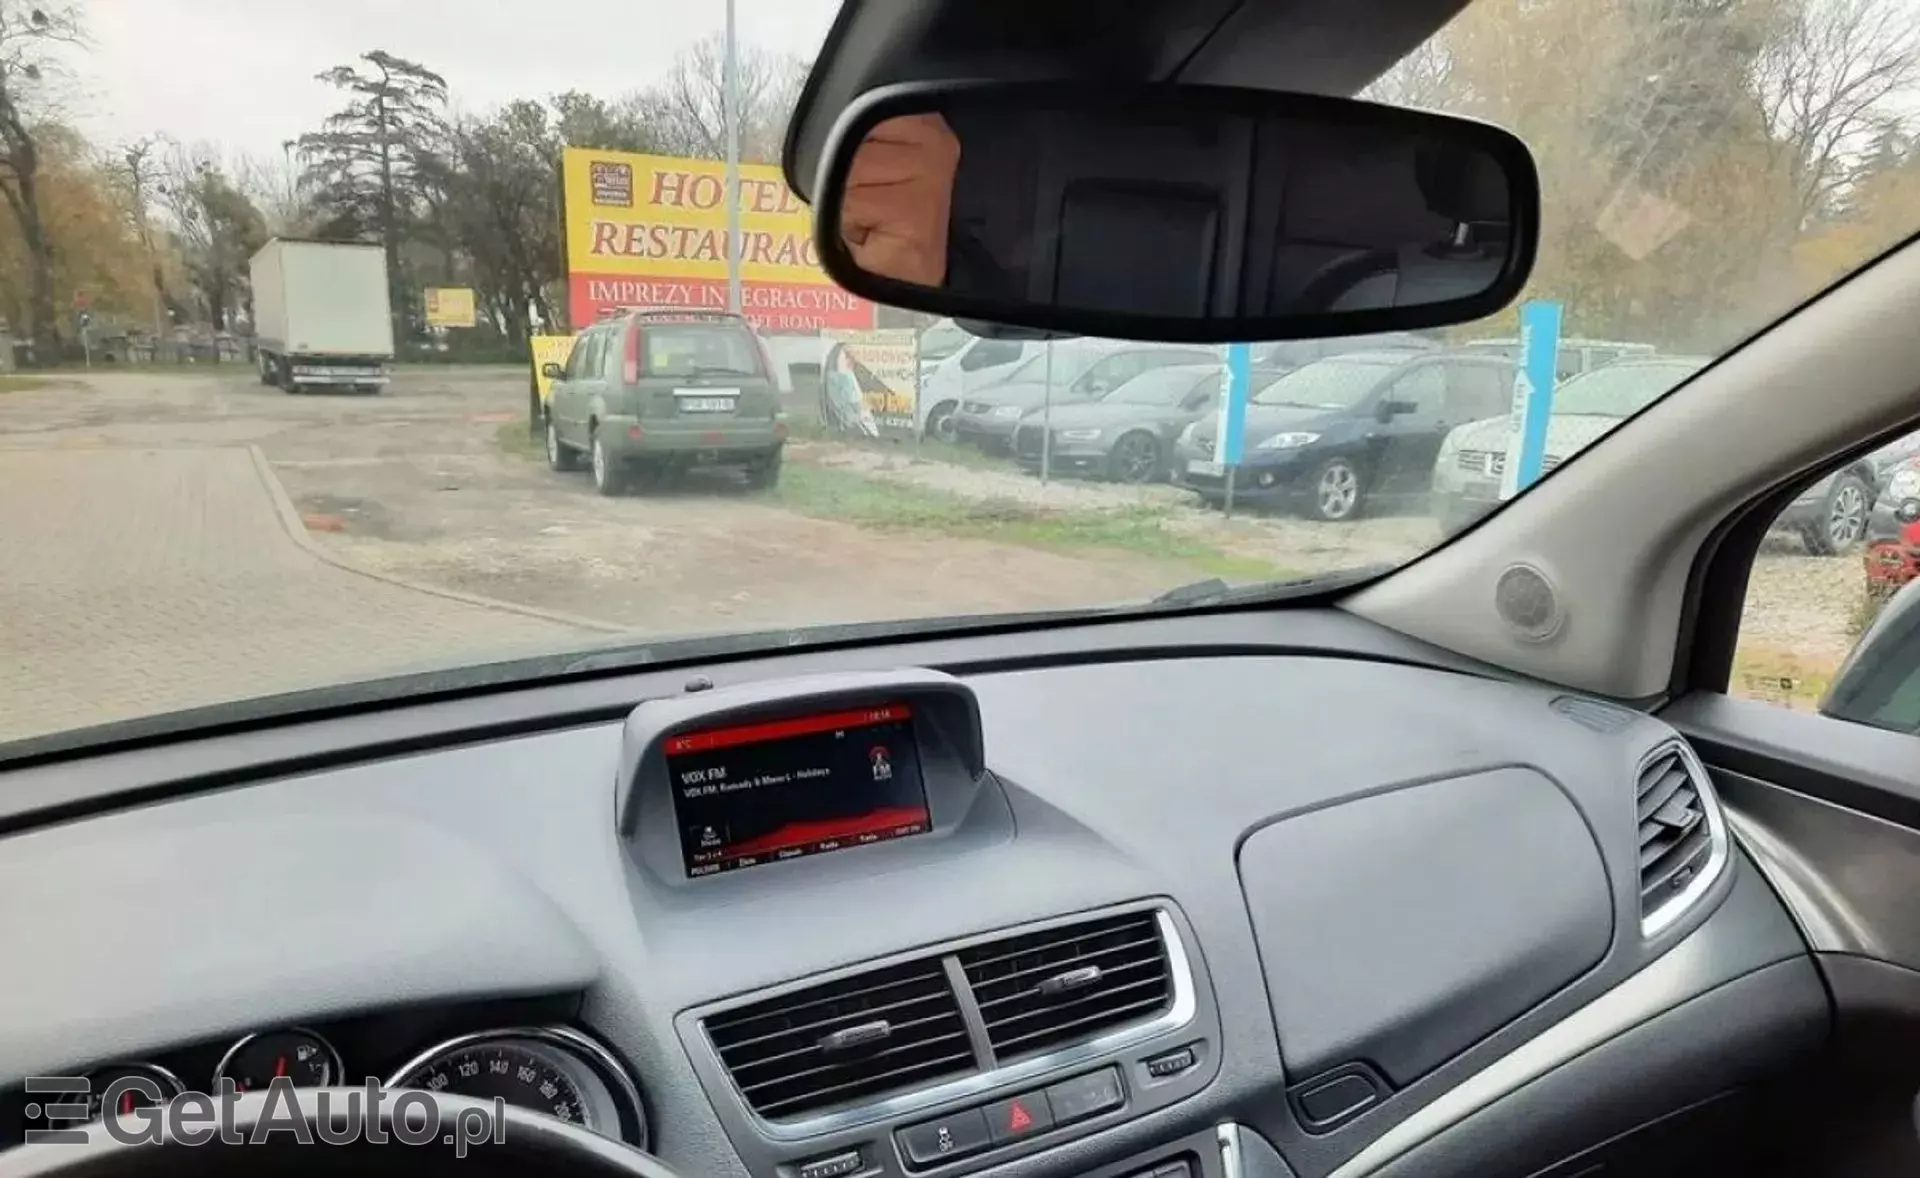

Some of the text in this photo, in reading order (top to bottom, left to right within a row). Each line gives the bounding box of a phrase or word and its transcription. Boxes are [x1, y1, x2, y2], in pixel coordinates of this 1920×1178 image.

[589, 280, 858, 312] IMPREZY INEGRACYJNE
[682, 766, 727, 784] VOX FM
[458, 1060, 480, 1077] 120
[489, 1060, 509, 1075] 140
